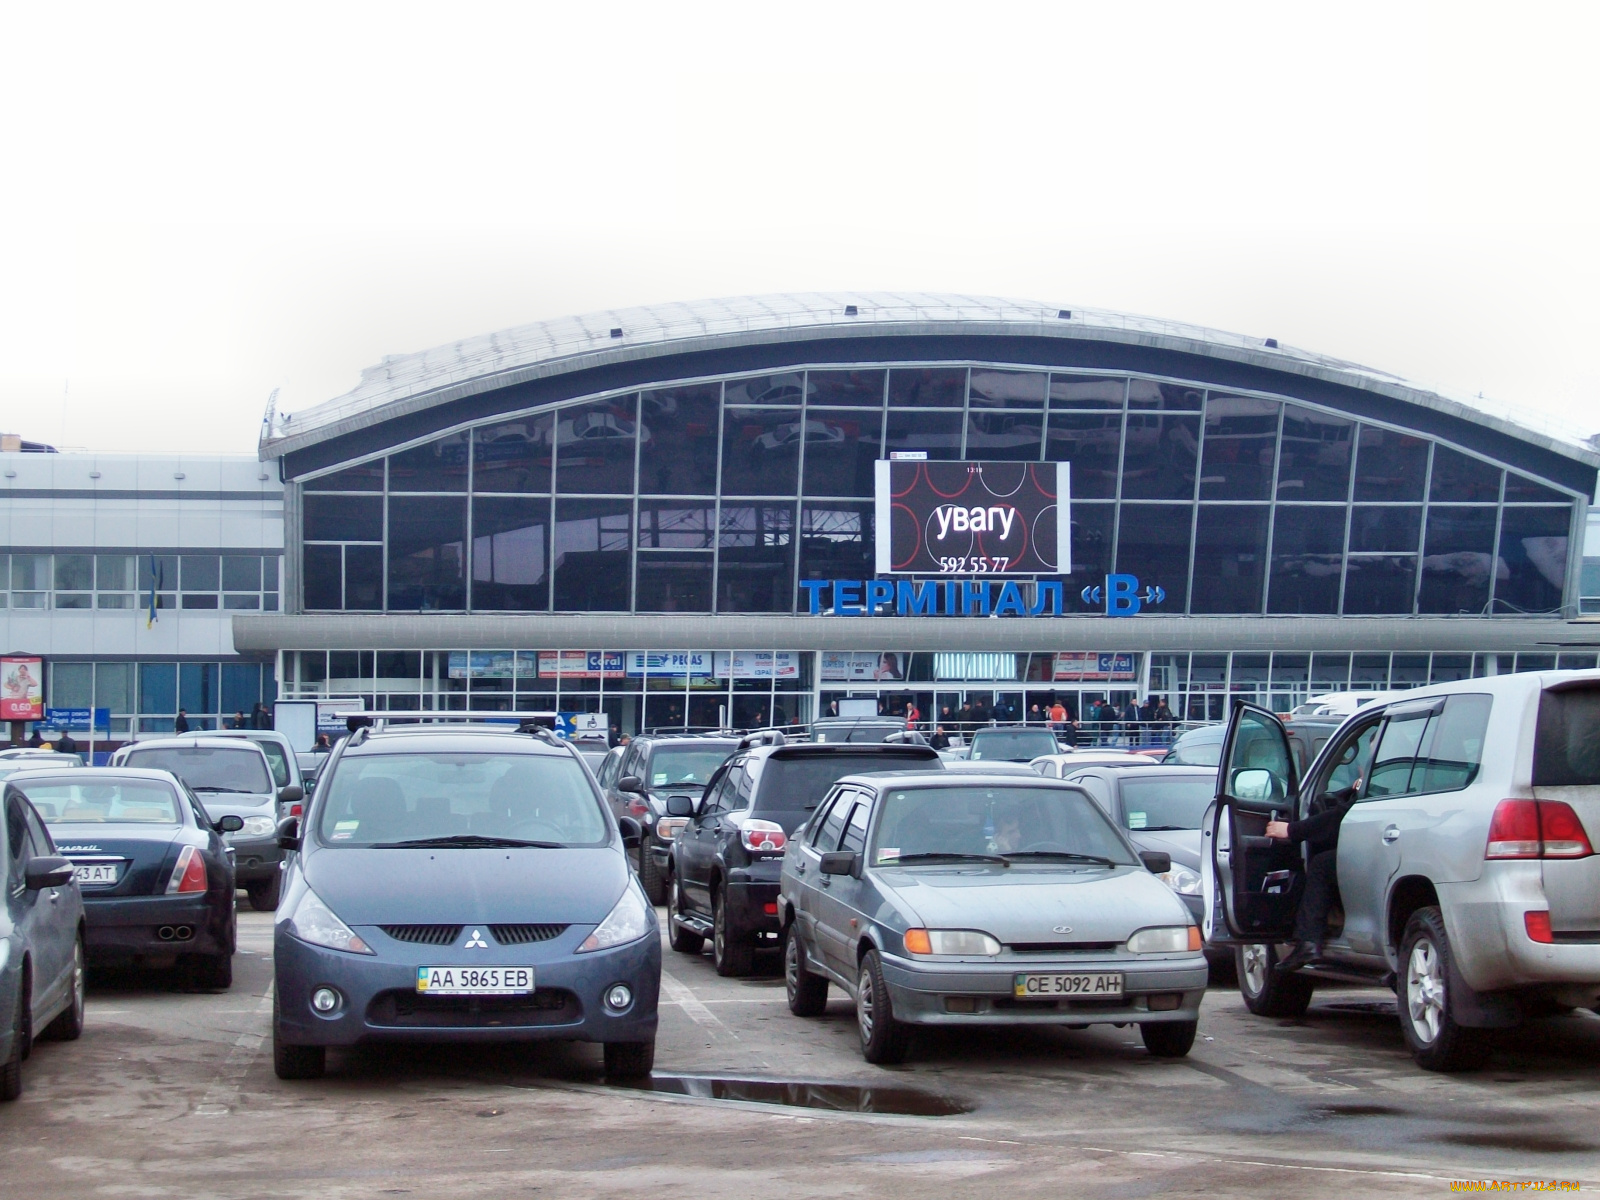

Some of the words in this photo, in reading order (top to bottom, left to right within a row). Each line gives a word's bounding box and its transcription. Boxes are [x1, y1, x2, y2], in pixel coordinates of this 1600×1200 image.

[936, 506, 1015, 540] увагу
[939, 556, 966, 572] 592
[970, 556, 988, 572] 55
[991, 556, 1010, 572] 77
[799, 579, 1063, 616] ТЕРМІНАЛ
[589, 655, 621, 666] Coral
[1100, 657, 1131, 667] Coral
[75, 867, 91, 880] 43
[93, 867, 113, 880] AT
[430, 970, 455, 987] AA
[460, 970, 499, 987] 5865
[503, 970, 529, 987] EB
[1026, 977, 1050, 993] CE
[1054, 976, 1091, 993] 5092
[1094, 976, 1118, 992] AH
